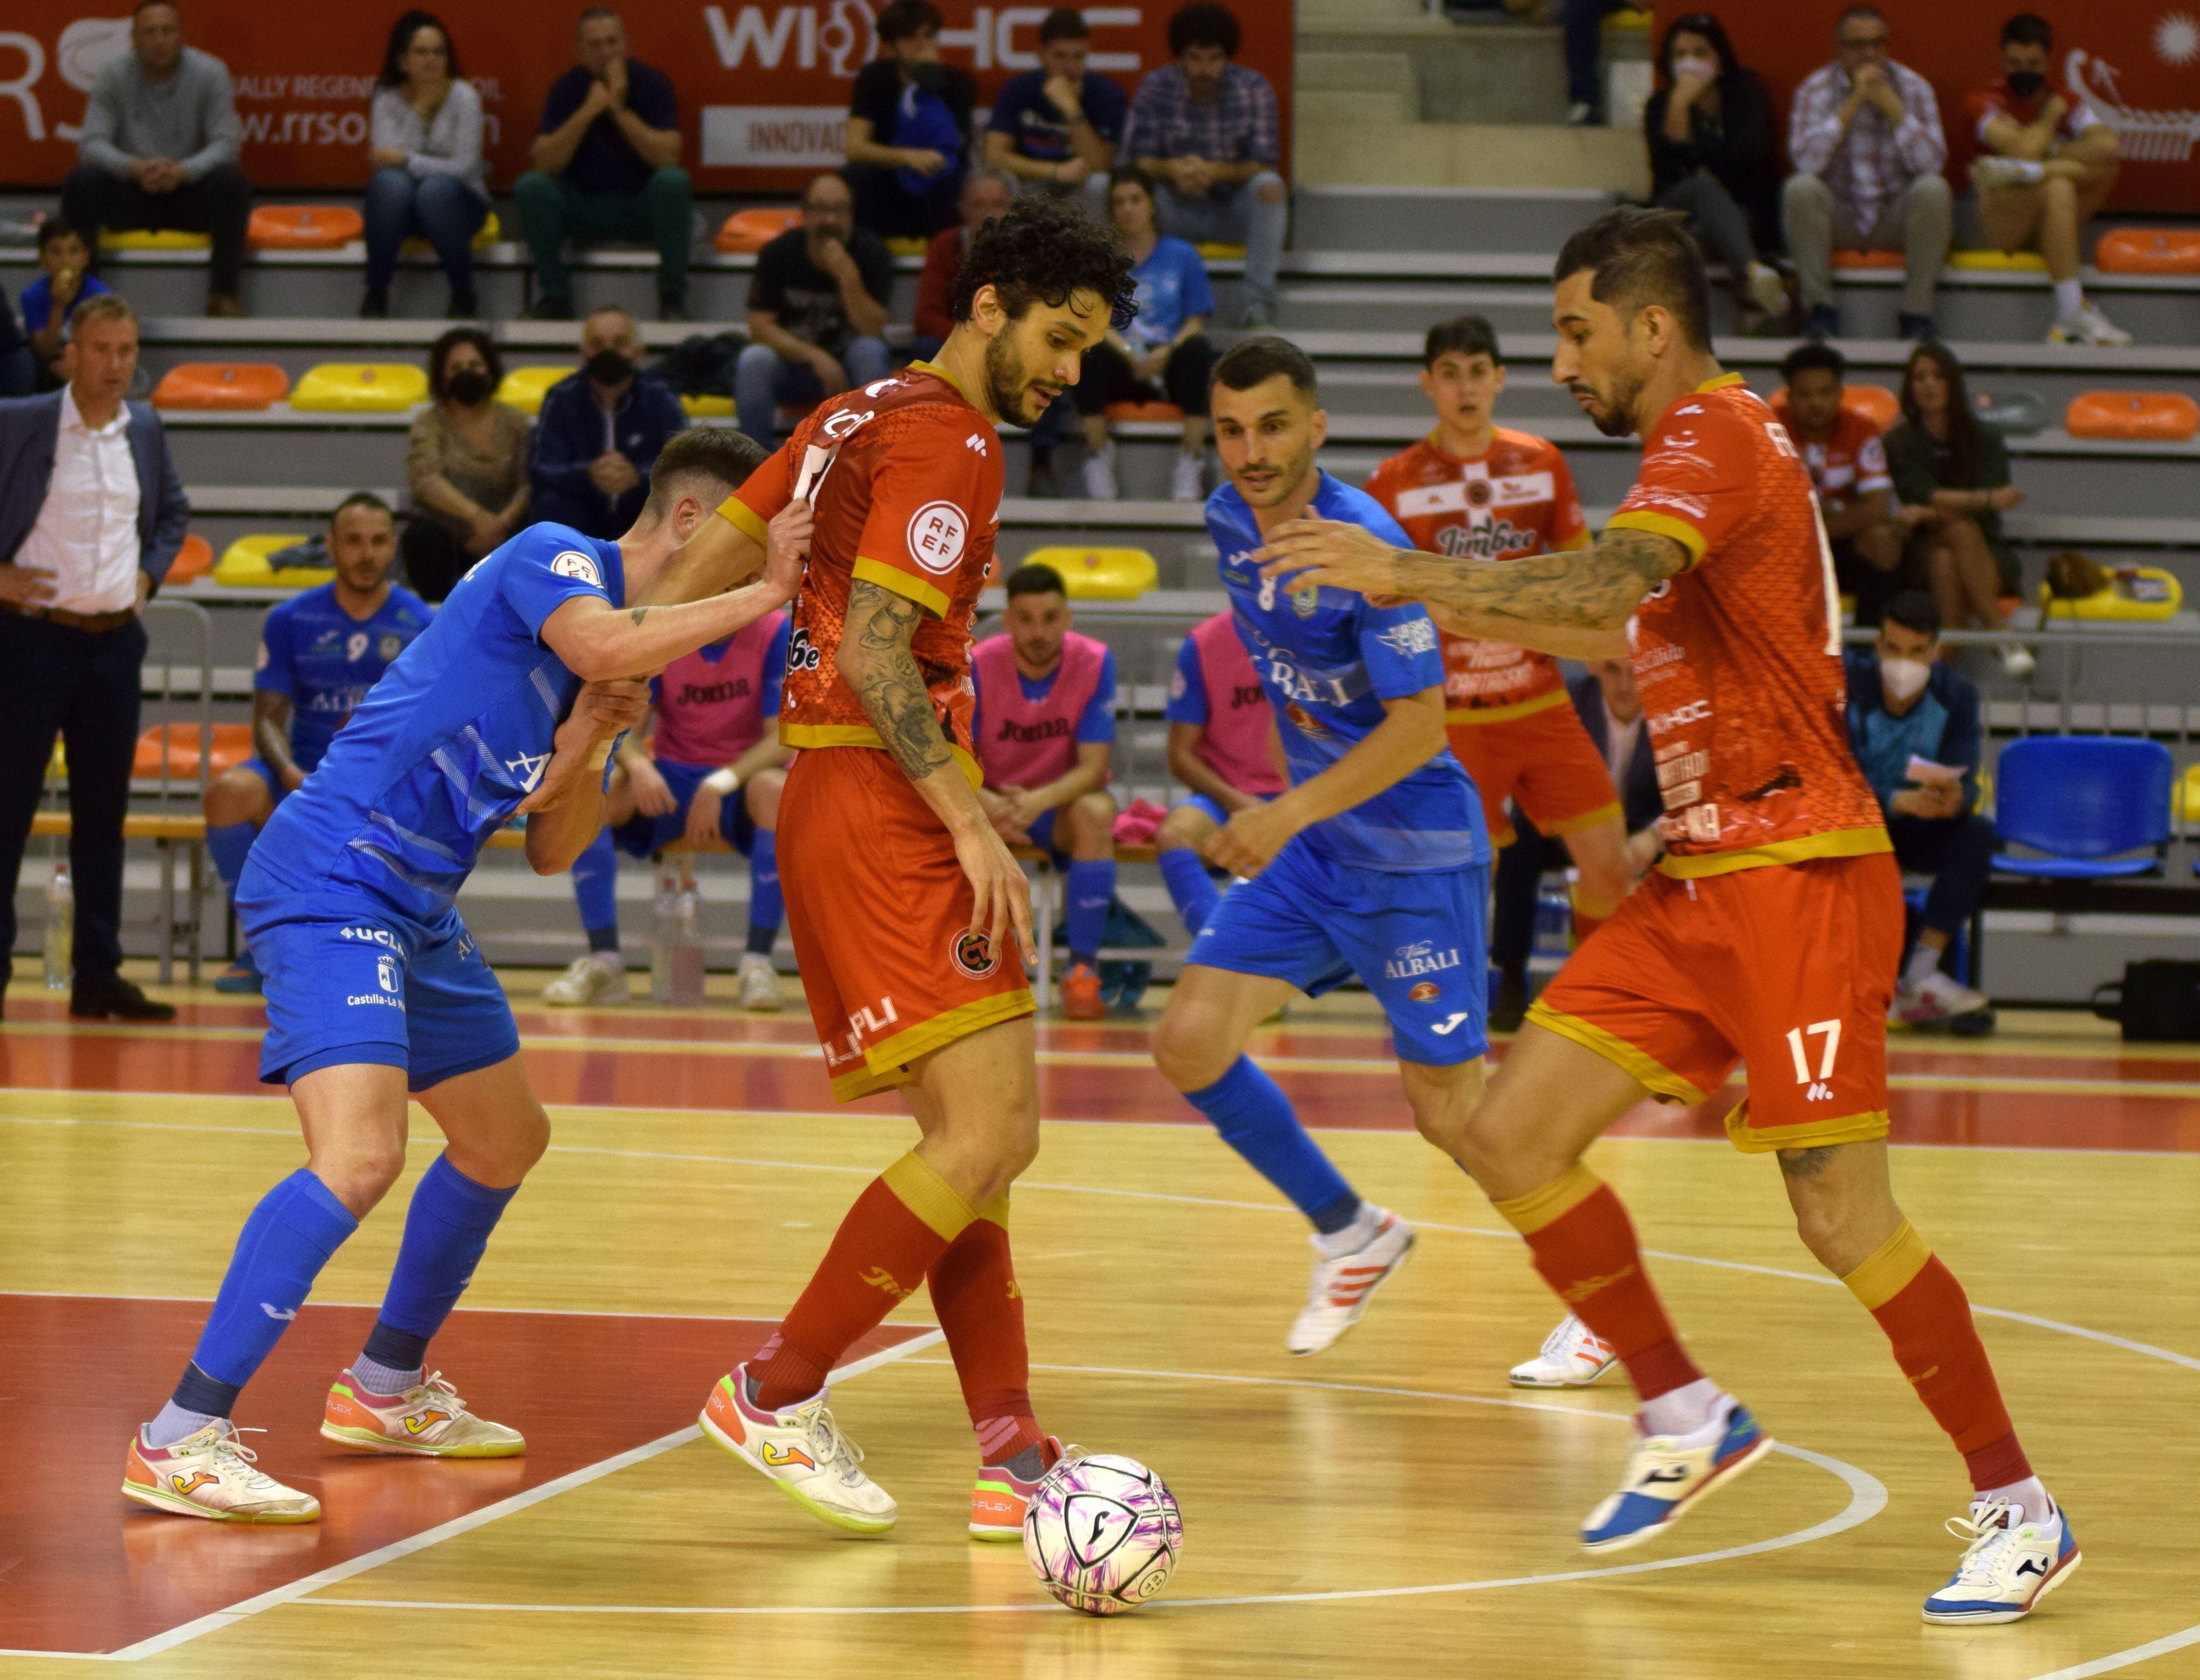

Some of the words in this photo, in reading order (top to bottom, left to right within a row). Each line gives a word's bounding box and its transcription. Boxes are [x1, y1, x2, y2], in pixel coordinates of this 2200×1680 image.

[347, 632, 369, 663] 9
[1386, 948, 1462, 978] ALBALI
[1785, 1019, 1842, 1085] 17
